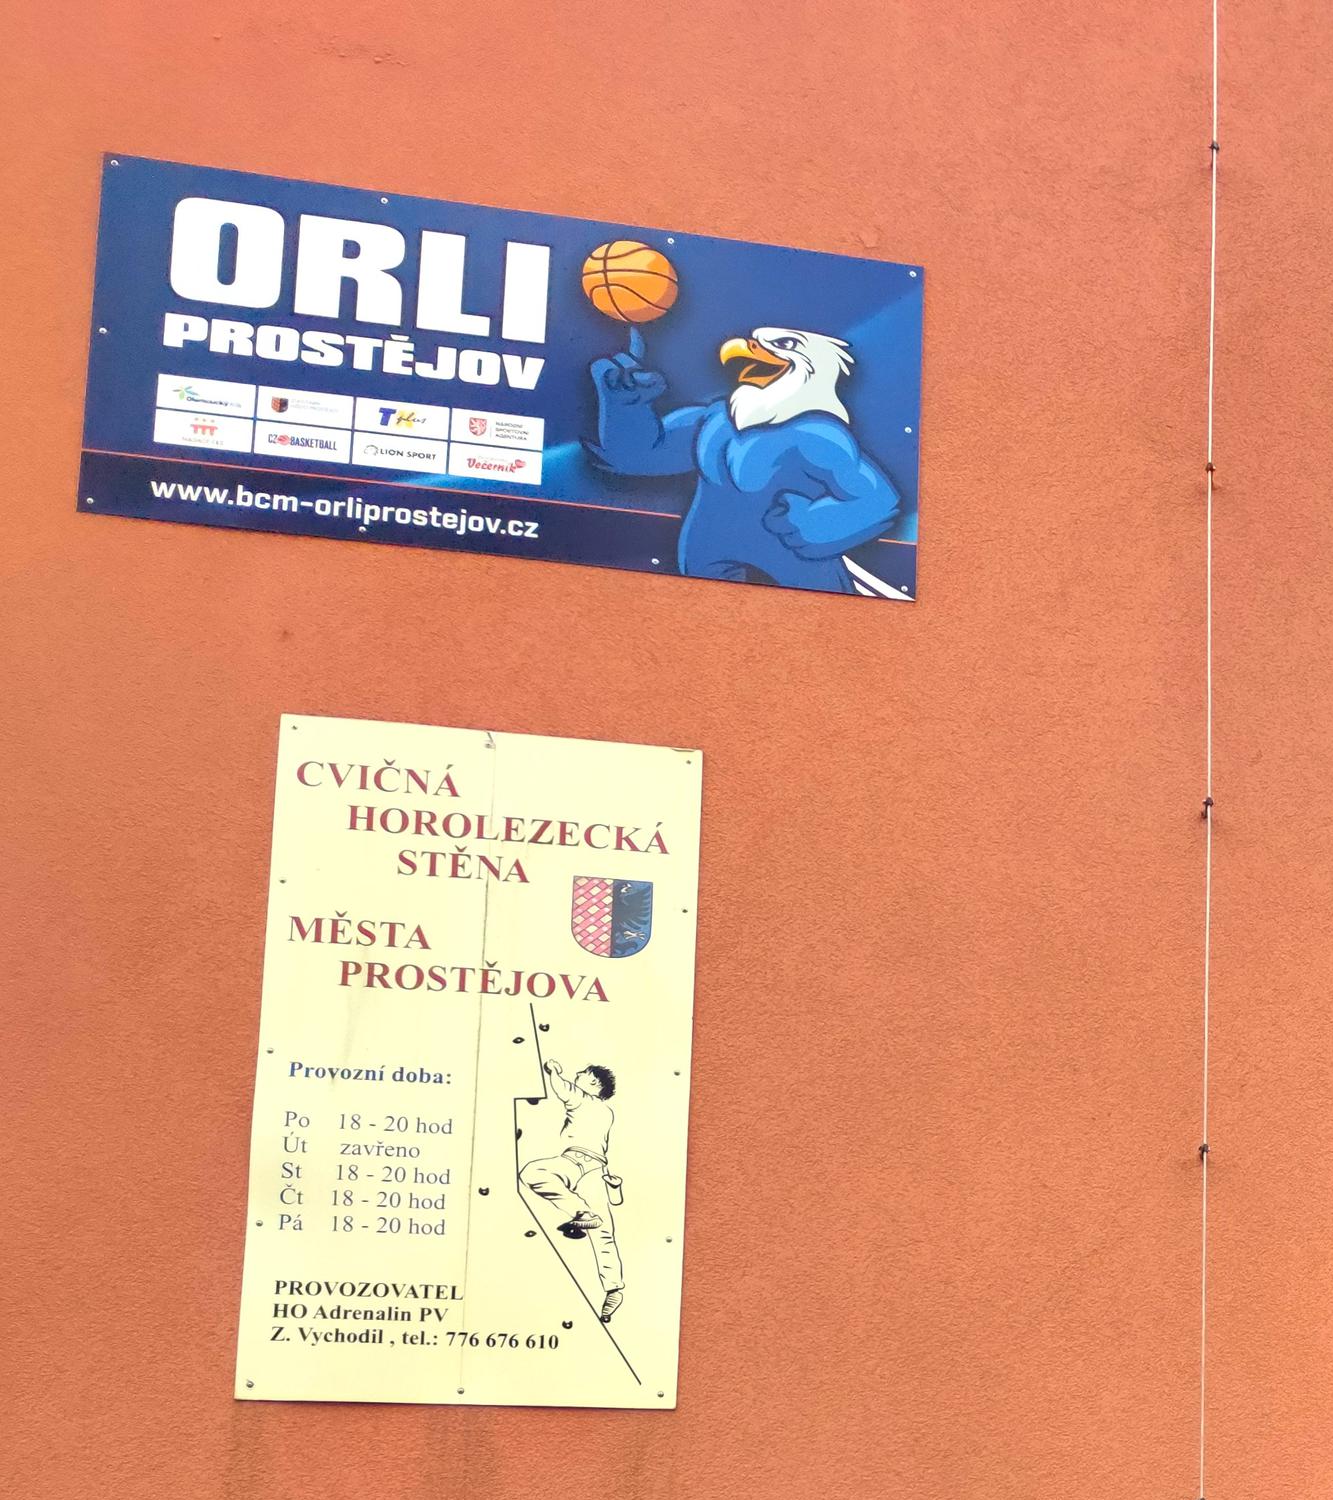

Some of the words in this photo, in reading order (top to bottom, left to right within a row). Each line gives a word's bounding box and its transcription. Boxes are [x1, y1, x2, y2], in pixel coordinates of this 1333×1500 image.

[169, 196, 551, 344] ORLI
[162, 311, 546, 391] PROSTĚJOV
[267, 433, 279, 445] CZ
[290, 435, 338, 451] BASKETBALL
[380, 447, 404, 458] LION
[406, 449, 437, 462] SPORT
[149, 478, 540, 540] www.bcm-orliprostejov.cz
[296, 758, 461, 799] CVIČNÁ
[347, 804, 671, 855] HOROLEZECKÁ
[396, 846, 531, 884] STĚNA
[287, 911, 432, 950] MĚSTA
[337, 960, 611, 1003] PROSTĚJOVA
[288, 1061, 385, 1083] Provozní
[392, 1066, 453, 1086] doba:
[284, 1110, 311, 1129] Po
[338, 1112, 361, 1132] 18
[384, 1114, 409, 1134] 20
[415, 1115, 454, 1136] hod
[282, 1132, 307, 1154] Út
[339, 1141, 421, 1159] zavřeno
[280, 1161, 303, 1180] St
[336, 1163, 360, 1183] 18
[381, 1165, 407, 1185] 20
[413, 1166, 452, 1186] hod
[278, 1184, 304, 1207] Čt
[331, 1188, 355, 1208] 18
[376, 1190, 401, 1210] 20
[408, 1191, 447, 1211] hod
[277, 1213, 304, 1233] Pá
[331, 1215, 355, 1233] 18
[376, 1215, 401, 1235] 20
[408, 1216, 447, 1237] hod
[274, 1279, 464, 1302] PROVOZOVATEL
[272, 1303, 307, 1320] HO
[313, 1305, 412, 1322] Adrenalin
[419, 1306, 449, 1324] PV
[270, 1326, 291, 1343] Z.
[298, 1327, 384, 1347] Vychodil
[402, 1329, 438, 1347] tel.:
[446, 1330, 480, 1348] 776
[485, 1332, 520, 1350] 676
[525, 1332, 560, 1351] 610
